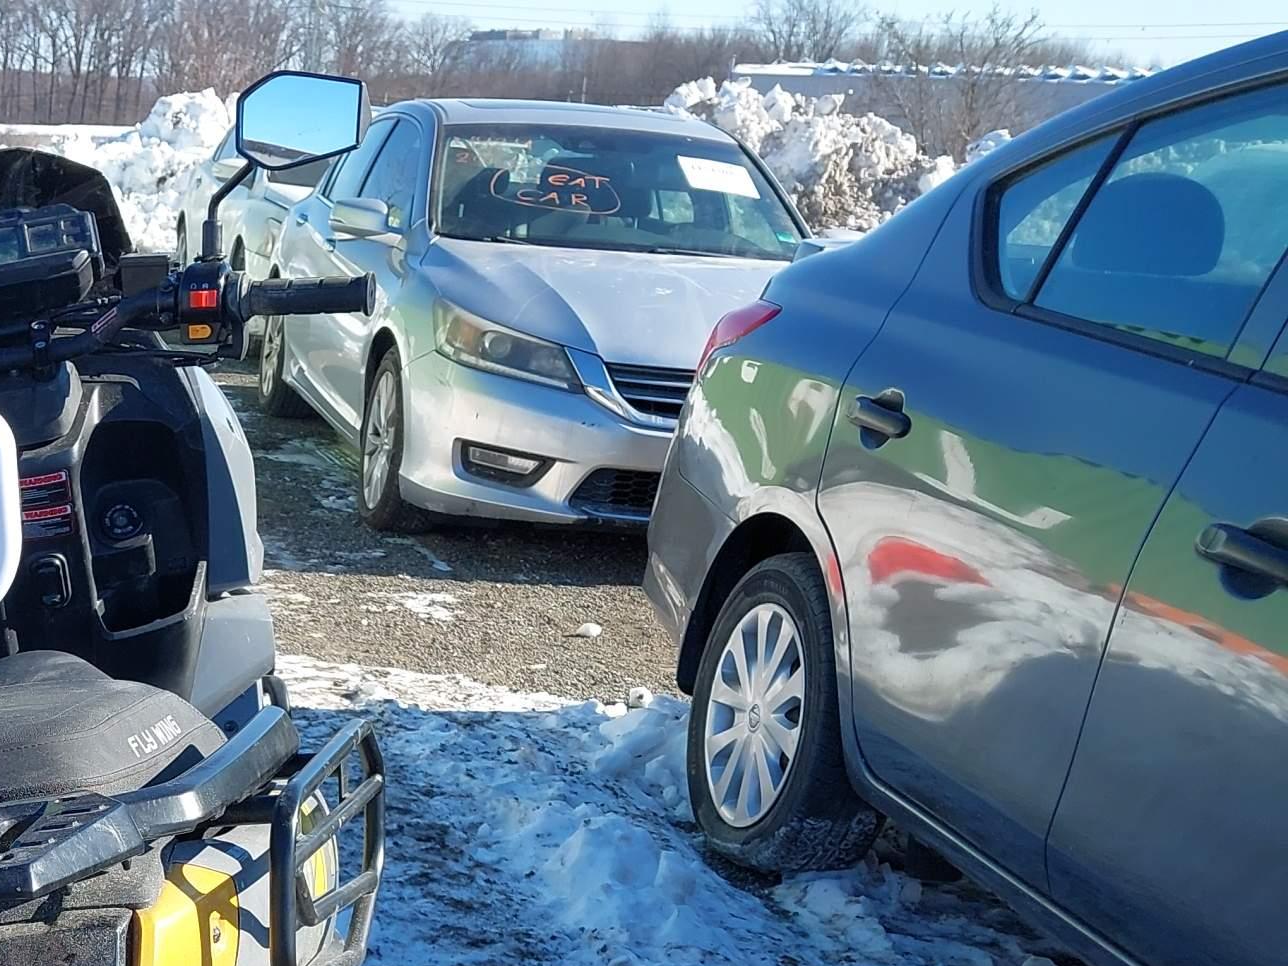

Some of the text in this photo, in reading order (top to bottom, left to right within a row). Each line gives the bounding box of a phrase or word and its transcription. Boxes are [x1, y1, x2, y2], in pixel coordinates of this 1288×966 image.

[548, 174, 610, 189] EAT
[517, 188, 589, 205] CAR
[127, 714, 182, 758] FLY WING
